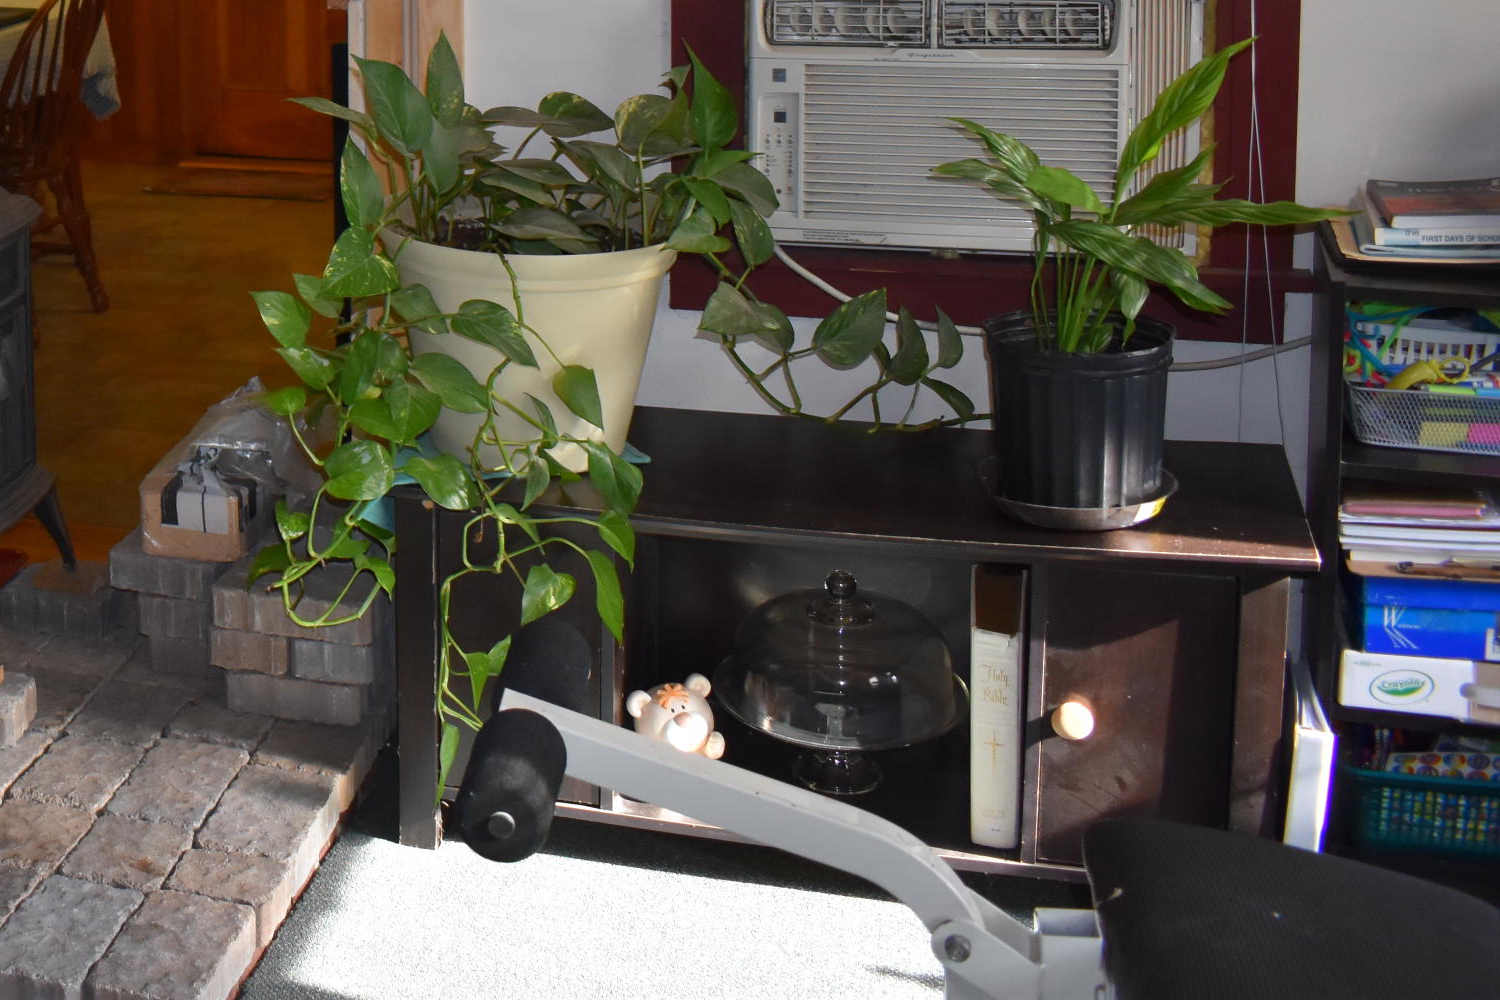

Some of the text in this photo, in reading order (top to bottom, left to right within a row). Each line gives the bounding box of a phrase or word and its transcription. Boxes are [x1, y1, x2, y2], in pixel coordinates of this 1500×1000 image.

[1421, 234, 1443, 243] FIRST
[1445, 234, 1464, 243] DAYS
[1465, 234, 1476, 242] OF
[1476, 234, 1500, 243] SCHO
[980, 664, 1011, 688] Holy
[1381, 678, 1420, 689] Crayola
[980, 688, 1010, 705] Bible
